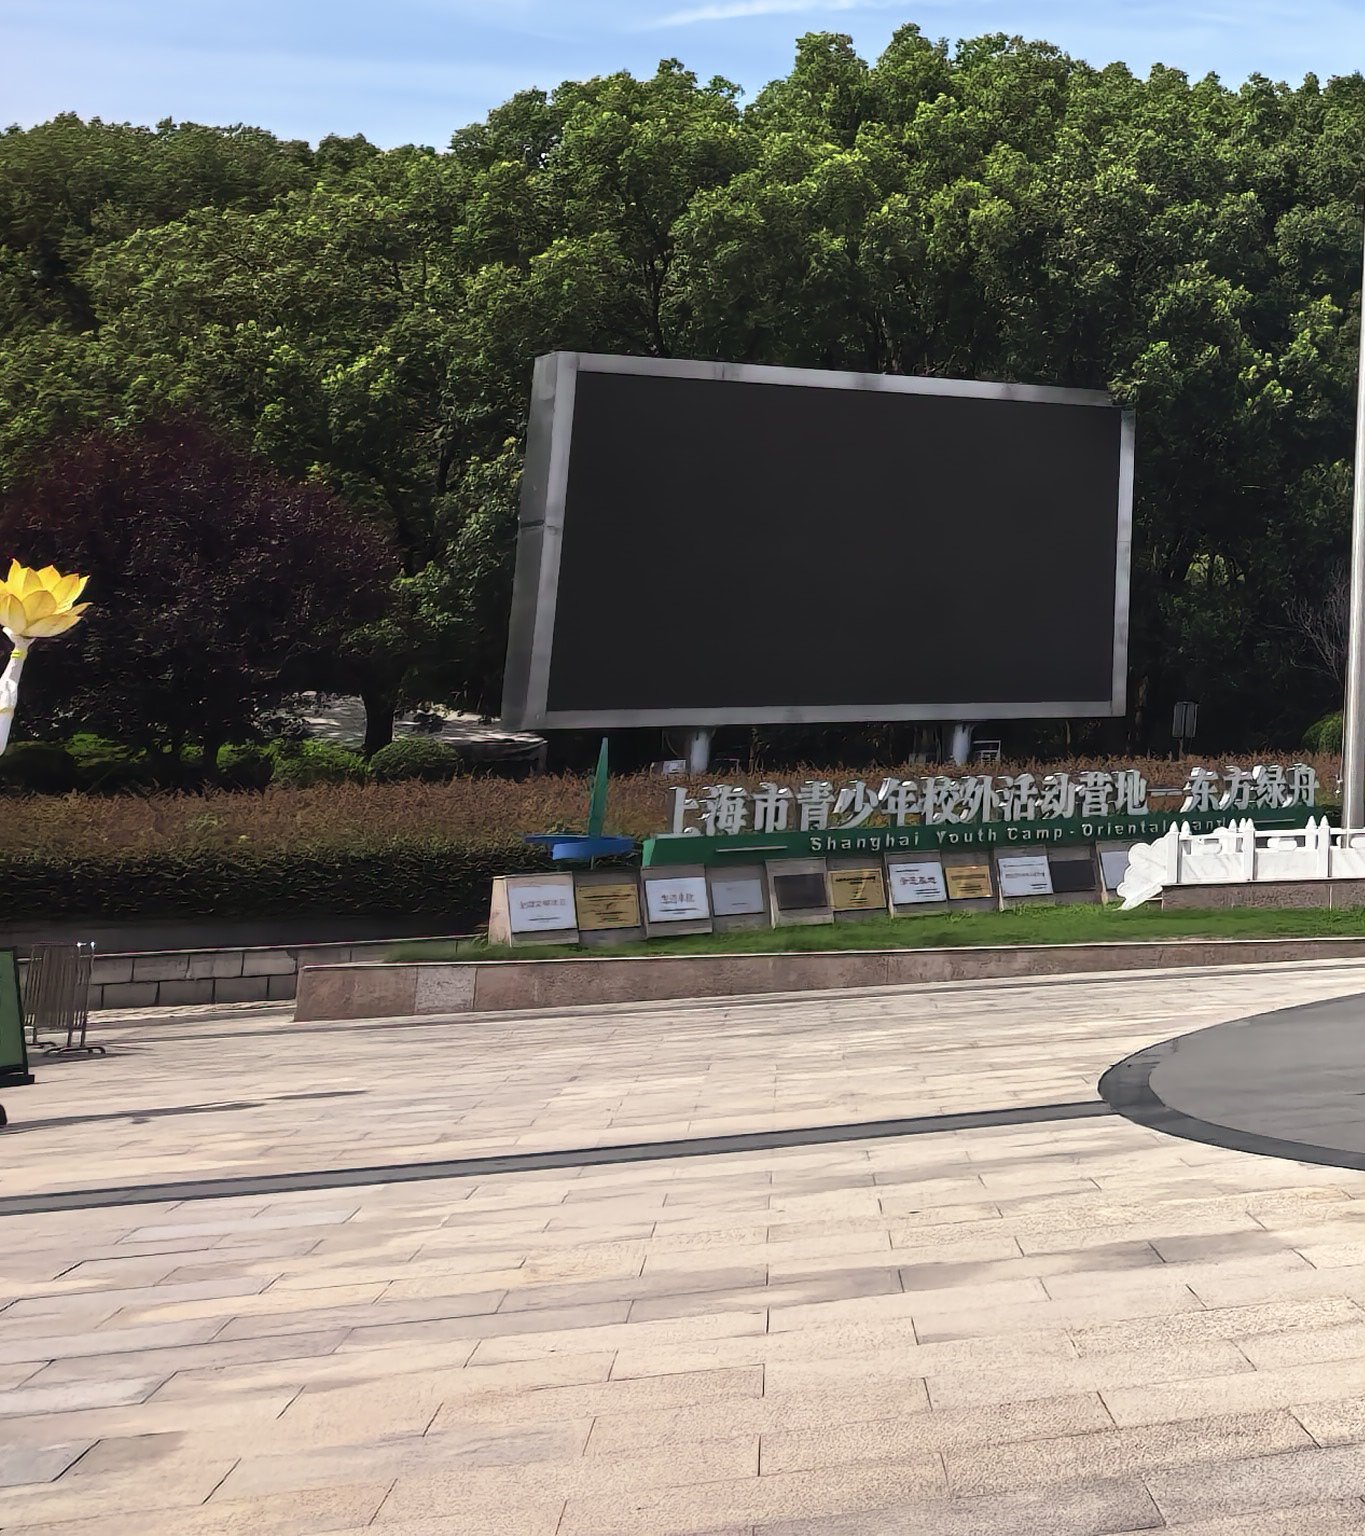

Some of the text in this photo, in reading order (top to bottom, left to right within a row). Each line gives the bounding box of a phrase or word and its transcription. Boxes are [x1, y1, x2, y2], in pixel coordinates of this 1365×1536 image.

[810, 831, 920, 852] Shanghai
[936, 828, 997, 845] Youth
[1182, 816, 1226, 834] and
